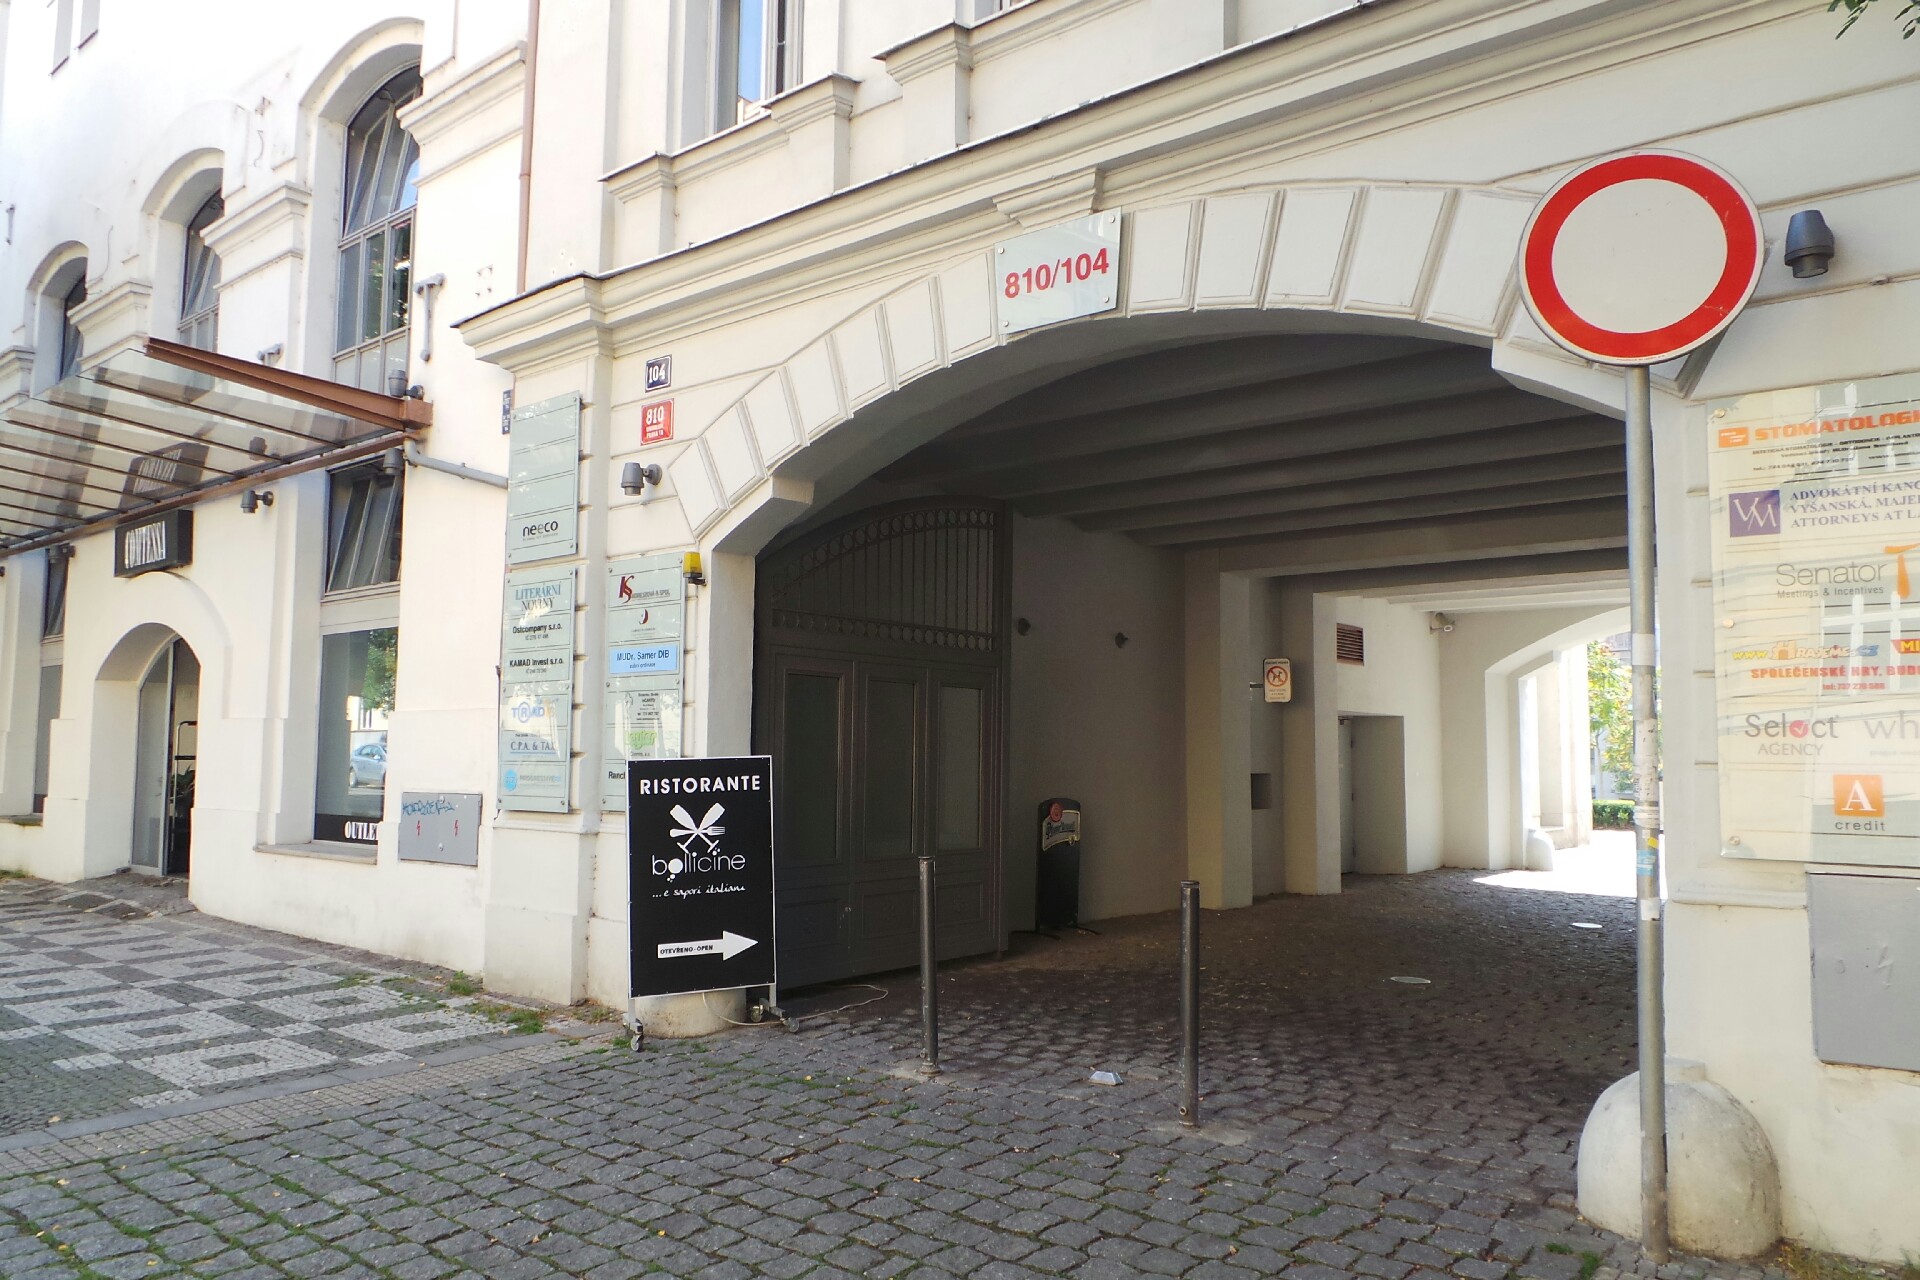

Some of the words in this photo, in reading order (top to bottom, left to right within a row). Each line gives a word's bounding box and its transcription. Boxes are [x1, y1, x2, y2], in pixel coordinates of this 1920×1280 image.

[1004, 247, 1109, 298] 810/104
[648, 363, 666, 383] 104
[646, 405, 664, 425] 810
[1790, 481, 1877, 501] ADVOKÁTNÍ
[1790, 497, 1872, 514] VYŠANSKÁ,
[1790, 512, 1879, 528] ATTORNEYS
[1883, 510, 1904, 521] AT
[523, 521, 558, 537] neeco
[1776, 562, 1887, 587] Senator
[515, 581, 562, 601] LITERÁRNÍ
[1777, 586, 1819, 598] Meetings
[1823, 587, 1829, 596] &
[1834, 586, 1884, 596] Incentives
[1751, 664, 1847, 678] SPOLEČENSKÉ
[1758, 743, 1824, 756] AGENCY
[640, 775, 761, 795] RISTORANTE
[1841, 780, 1877, 811] A
[1835, 820, 1886, 832] credit
[652, 850, 746, 877] bollicine
[673, 885, 702, 900] sapori
[697, 944, 713, 952] OPEN
